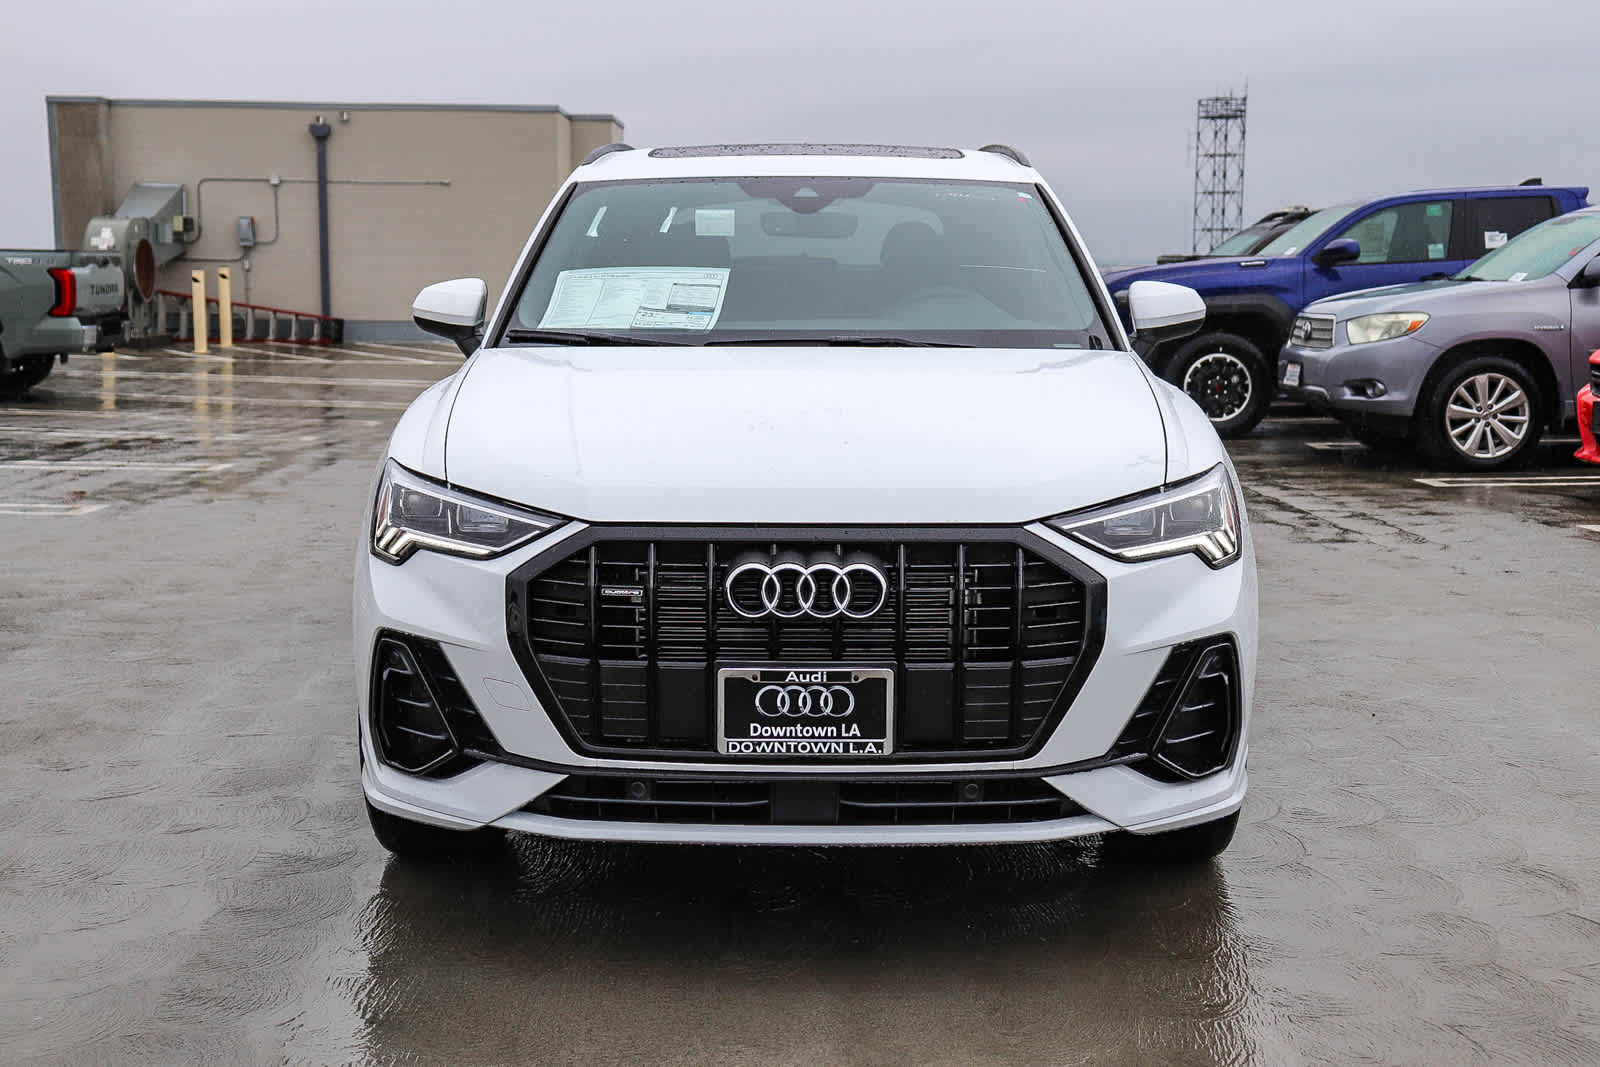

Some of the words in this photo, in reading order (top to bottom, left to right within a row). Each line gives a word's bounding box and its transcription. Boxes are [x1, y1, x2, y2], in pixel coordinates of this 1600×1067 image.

[90, 282, 119, 297] TUNDRA
[785, 671, 827, 682] Audi
[750, 723, 837, 737] Downtown
[841, 723, 861, 737] LA
[728, 741, 843, 754] DOWNTOWN
[849, 742, 882, 754] L.A.
